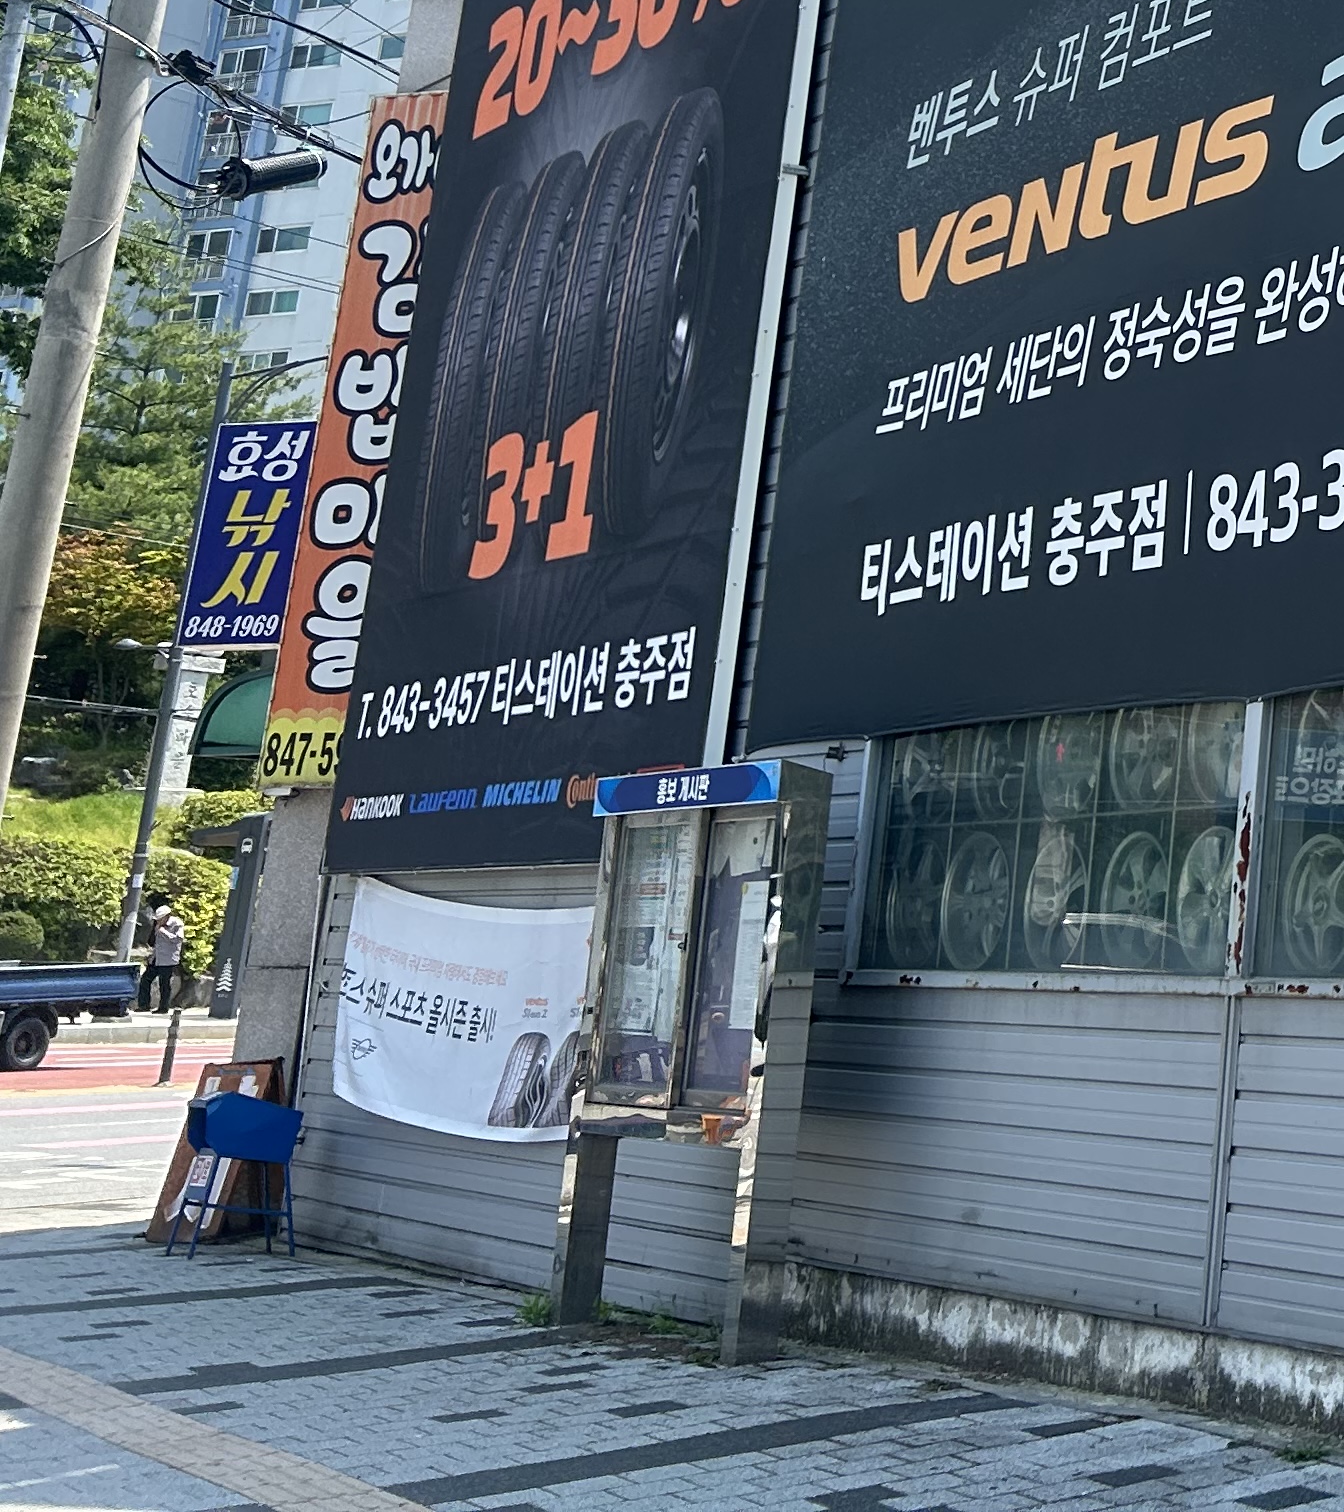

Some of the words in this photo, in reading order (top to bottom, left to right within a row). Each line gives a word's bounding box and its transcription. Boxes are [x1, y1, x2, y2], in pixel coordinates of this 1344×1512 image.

[907, 68, 999, 169] 벤투스
[1013, 24, 1090, 126] 슈퍼
[365, 120, 441, 202] 오가
[876, 345, 993, 434] 프리미엄
[996, 315, 1095, 405] 세단의
[1103, 275, 1245, 381] 정숙성을
[218, 431, 310, 483] 효성
[468, 410, 599, 580] 3+1
[201, 489, 290, 608] 낚시
[858, 505, 1033, 616] 티스테이션
[1046, 478, 1169, 586] 충주점
[185, 615, 279, 638] 848-1969
[357, 692, 371, 740] T.
[378, 670, 491, 738] 843-3457
[491, 641, 610, 725] 티스테이션
[614, 626, 697, 709] 충주점
[481, 778, 562, 808] MICHELIN
[657, 780, 677, 805] 홍보
[678, 773, 709, 801] 게시판
[364, 978, 391, 1019] 슈퍼
[386, 987, 428, 1026] 스포츠
[425, 994, 468, 1040] 올시즌
